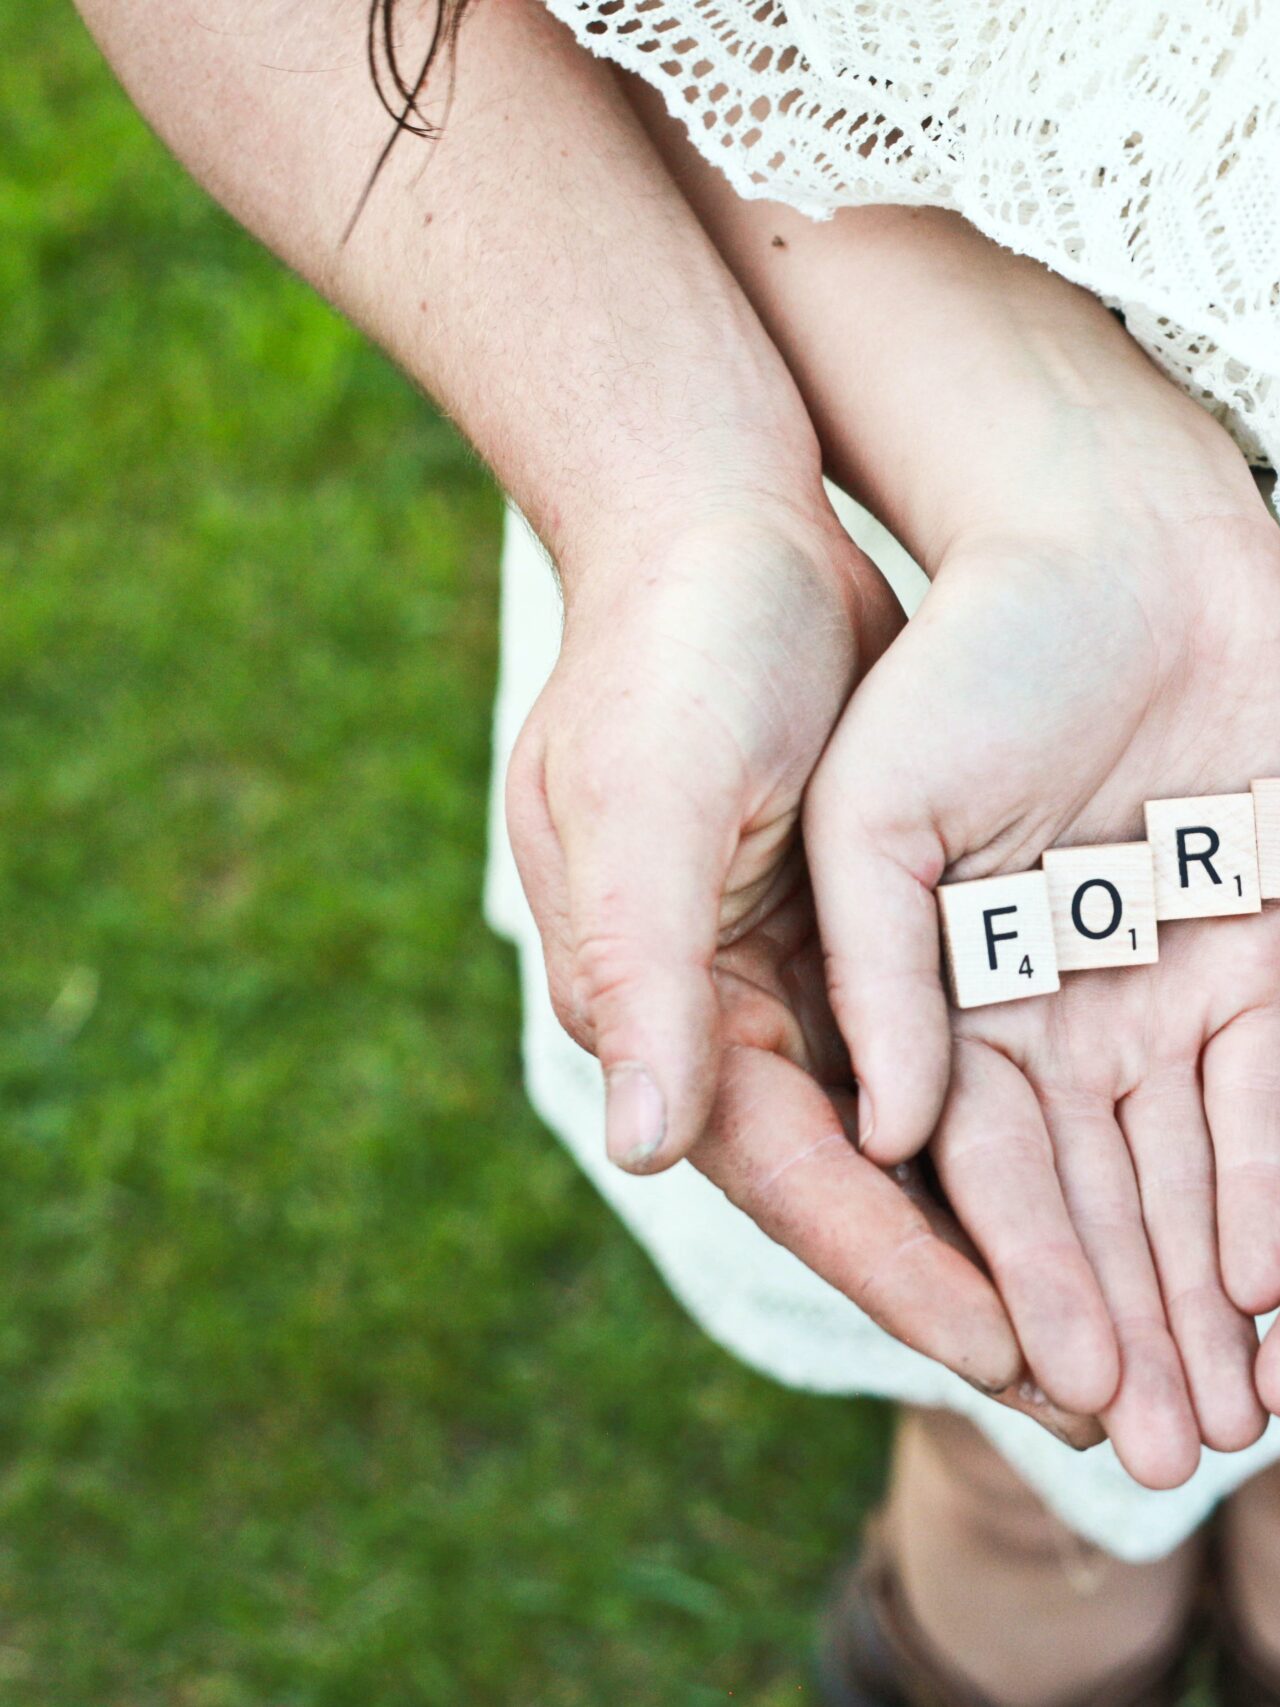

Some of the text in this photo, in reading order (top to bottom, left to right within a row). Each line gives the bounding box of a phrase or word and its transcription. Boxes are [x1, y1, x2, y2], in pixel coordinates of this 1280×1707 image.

[1232, 874, 1244, 897] 1
[1127, 928, 1138, 951] 1
[1017, 954, 1035, 979] 4
